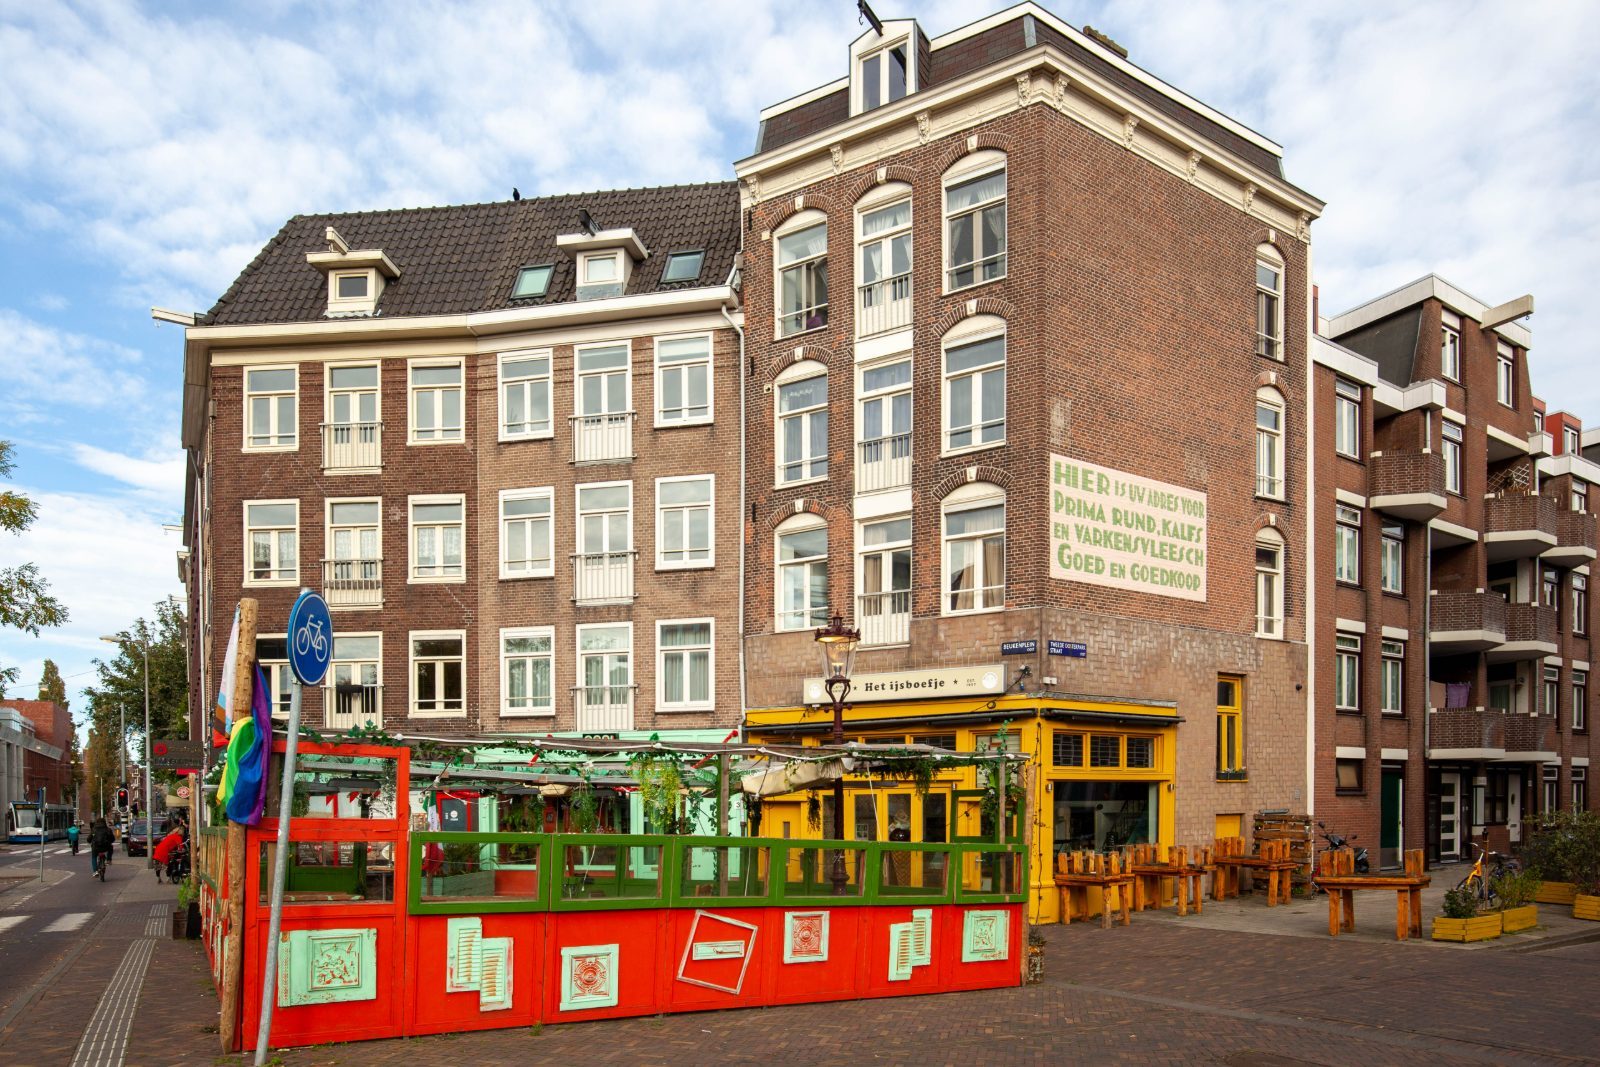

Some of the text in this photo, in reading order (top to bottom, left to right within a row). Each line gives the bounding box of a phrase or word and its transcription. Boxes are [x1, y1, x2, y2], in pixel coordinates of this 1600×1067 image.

[1054, 461, 1205, 519] HIER IS UW ADRES VOOR
[1054, 490, 1106, 523] PRIMA
[1053, 522, 1204, 567] EN VARKENSVLEESCH
[1057, 542, 1201, 592] GOED EN GOEDKOOP
[865, 678, 945, 692] Het ijsboefje
